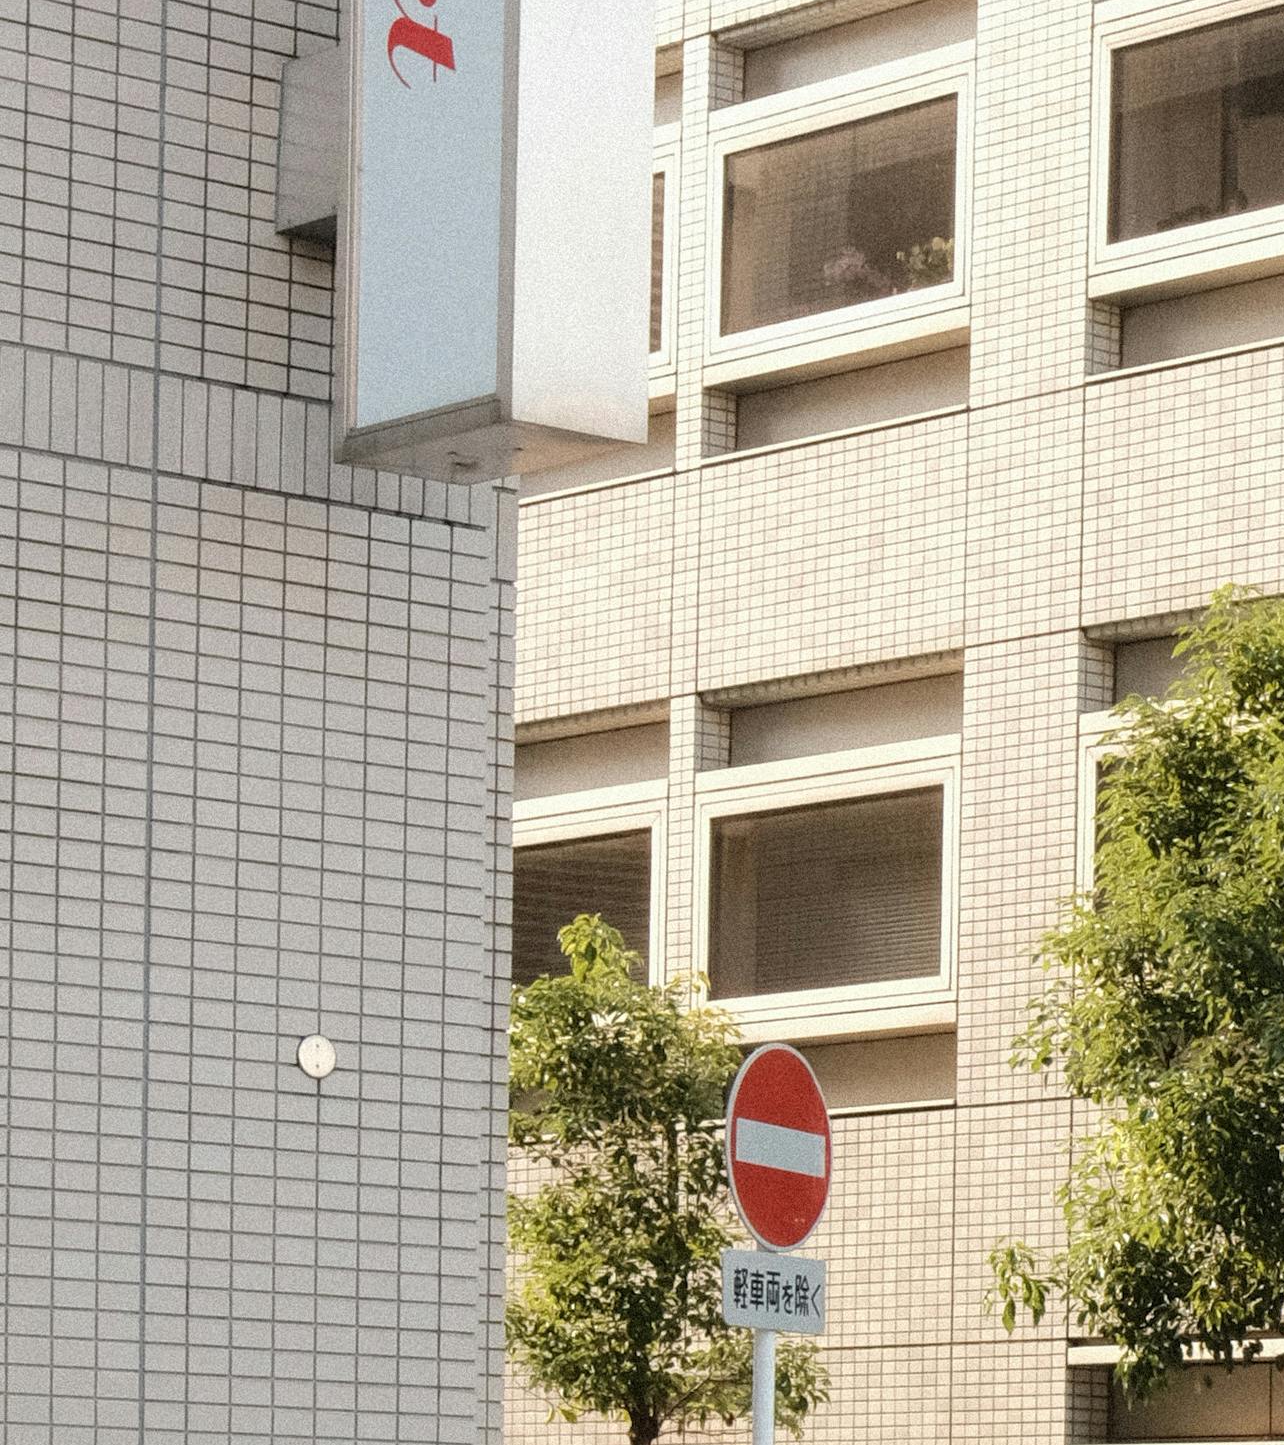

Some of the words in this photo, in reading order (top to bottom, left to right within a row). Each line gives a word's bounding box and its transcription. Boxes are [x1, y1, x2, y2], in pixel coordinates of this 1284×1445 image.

[733, 1268, 821, 1317] 軽車両を除く
